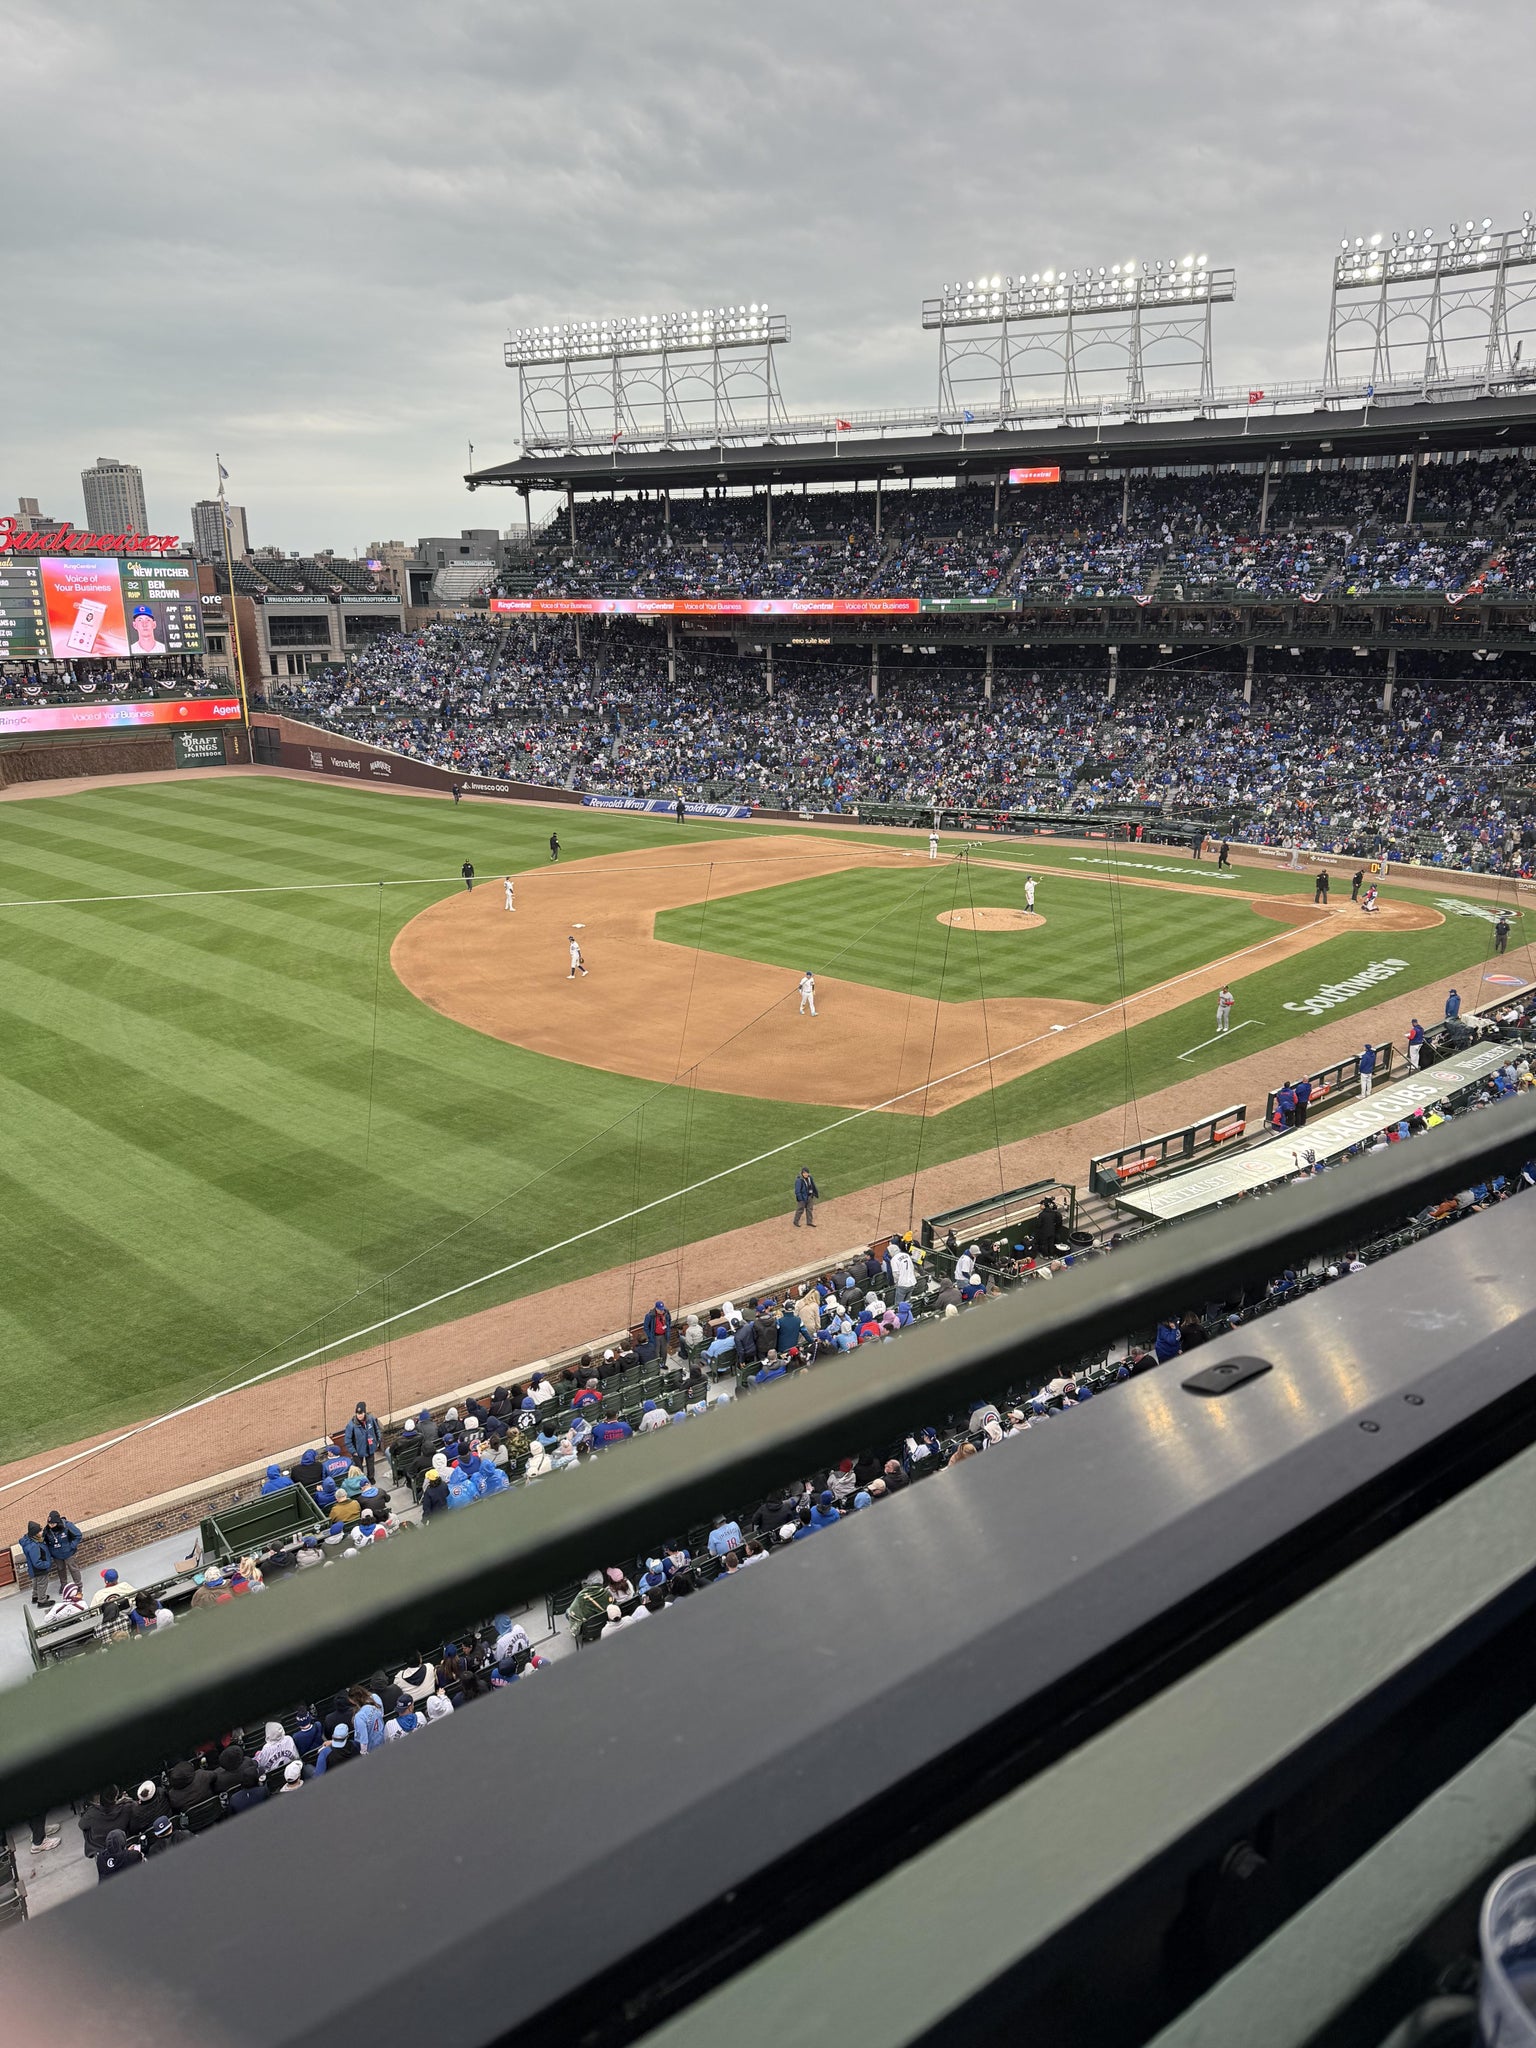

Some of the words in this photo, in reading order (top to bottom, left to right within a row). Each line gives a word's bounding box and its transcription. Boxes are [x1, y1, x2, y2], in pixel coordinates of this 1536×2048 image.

[0, 517, 179, 552] Budweiser
[134, 568, 152, 577] NEW
[154, 568, 190, 577] PITCHER
[65, 575, 89, 583] Voice
[90, 575, 98, 583] of
[55, 584, 73, 592] Your
[75, 584, 112, 592] Business
[128, 582, 139, 590] 32
[148, 581, 166, 589] BEN
[149, 590, 180, 599] BROWN
[201, 595, 222, 605] ore
[498, 602, 532, 610] RingCentral
[792, 603, 834, 611] RingCentral
[882, 602, 910, 610] Business
[72, 713, 92, 722] Voice
[103, 711, 120, 720] Your
[120, 710, 154, 719] Business
[213, 705, 240, 716] Agent
[183, 737, 217, 748] DRAFT
[188, 744, 218, 753] KINGS
[184, 751, 222, 759] SPORTSBOOK
[330, 757, 348, 769] Vienna
[348, 760, 360, 772] Beef
[370, 761, 392, 774] MARQUEE
[472, 783, 495, 791] Invesco
[590, 797, 623, 809] Reynolds
[623, 800, 645, 811] Wrap
[705, 804, 727, 816] Wrap
[1087, 858, 1242, 880] Southwest
[1283, 961, 1404, 1015] Southwest
[1278, 1110, 1385, 1160] CHICAGO
[1372, 1084, 1439, 1113] CUBS
[1139, 1175, 1230, 1209] WINTRUST
[903, 1260, 909, 1270] 7
